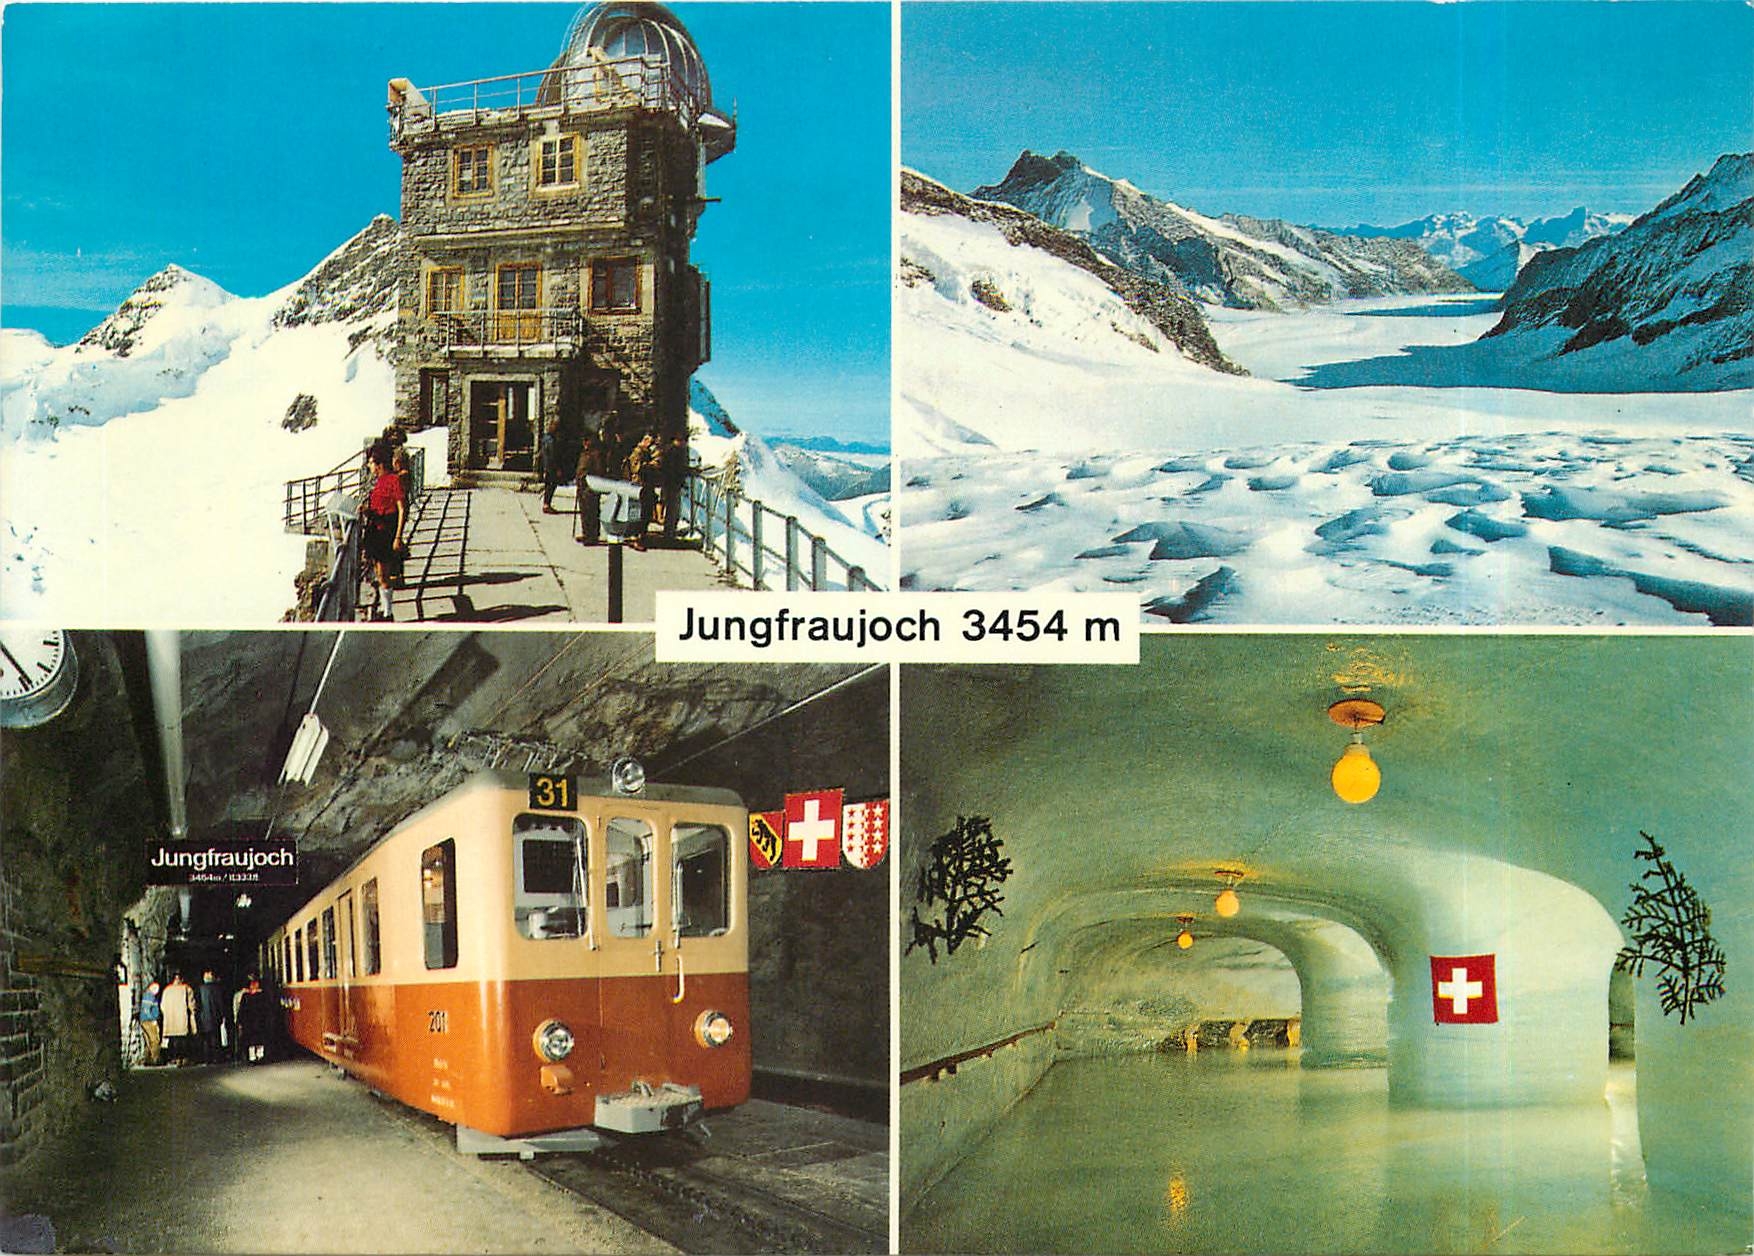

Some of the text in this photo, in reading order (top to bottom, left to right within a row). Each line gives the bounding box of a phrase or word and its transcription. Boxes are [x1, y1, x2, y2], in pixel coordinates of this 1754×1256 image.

[536, 776, 568, 807] 31
[151, 847, 294, 871] Jungfraujoch
[428, 1010, 447, 1034] 201
